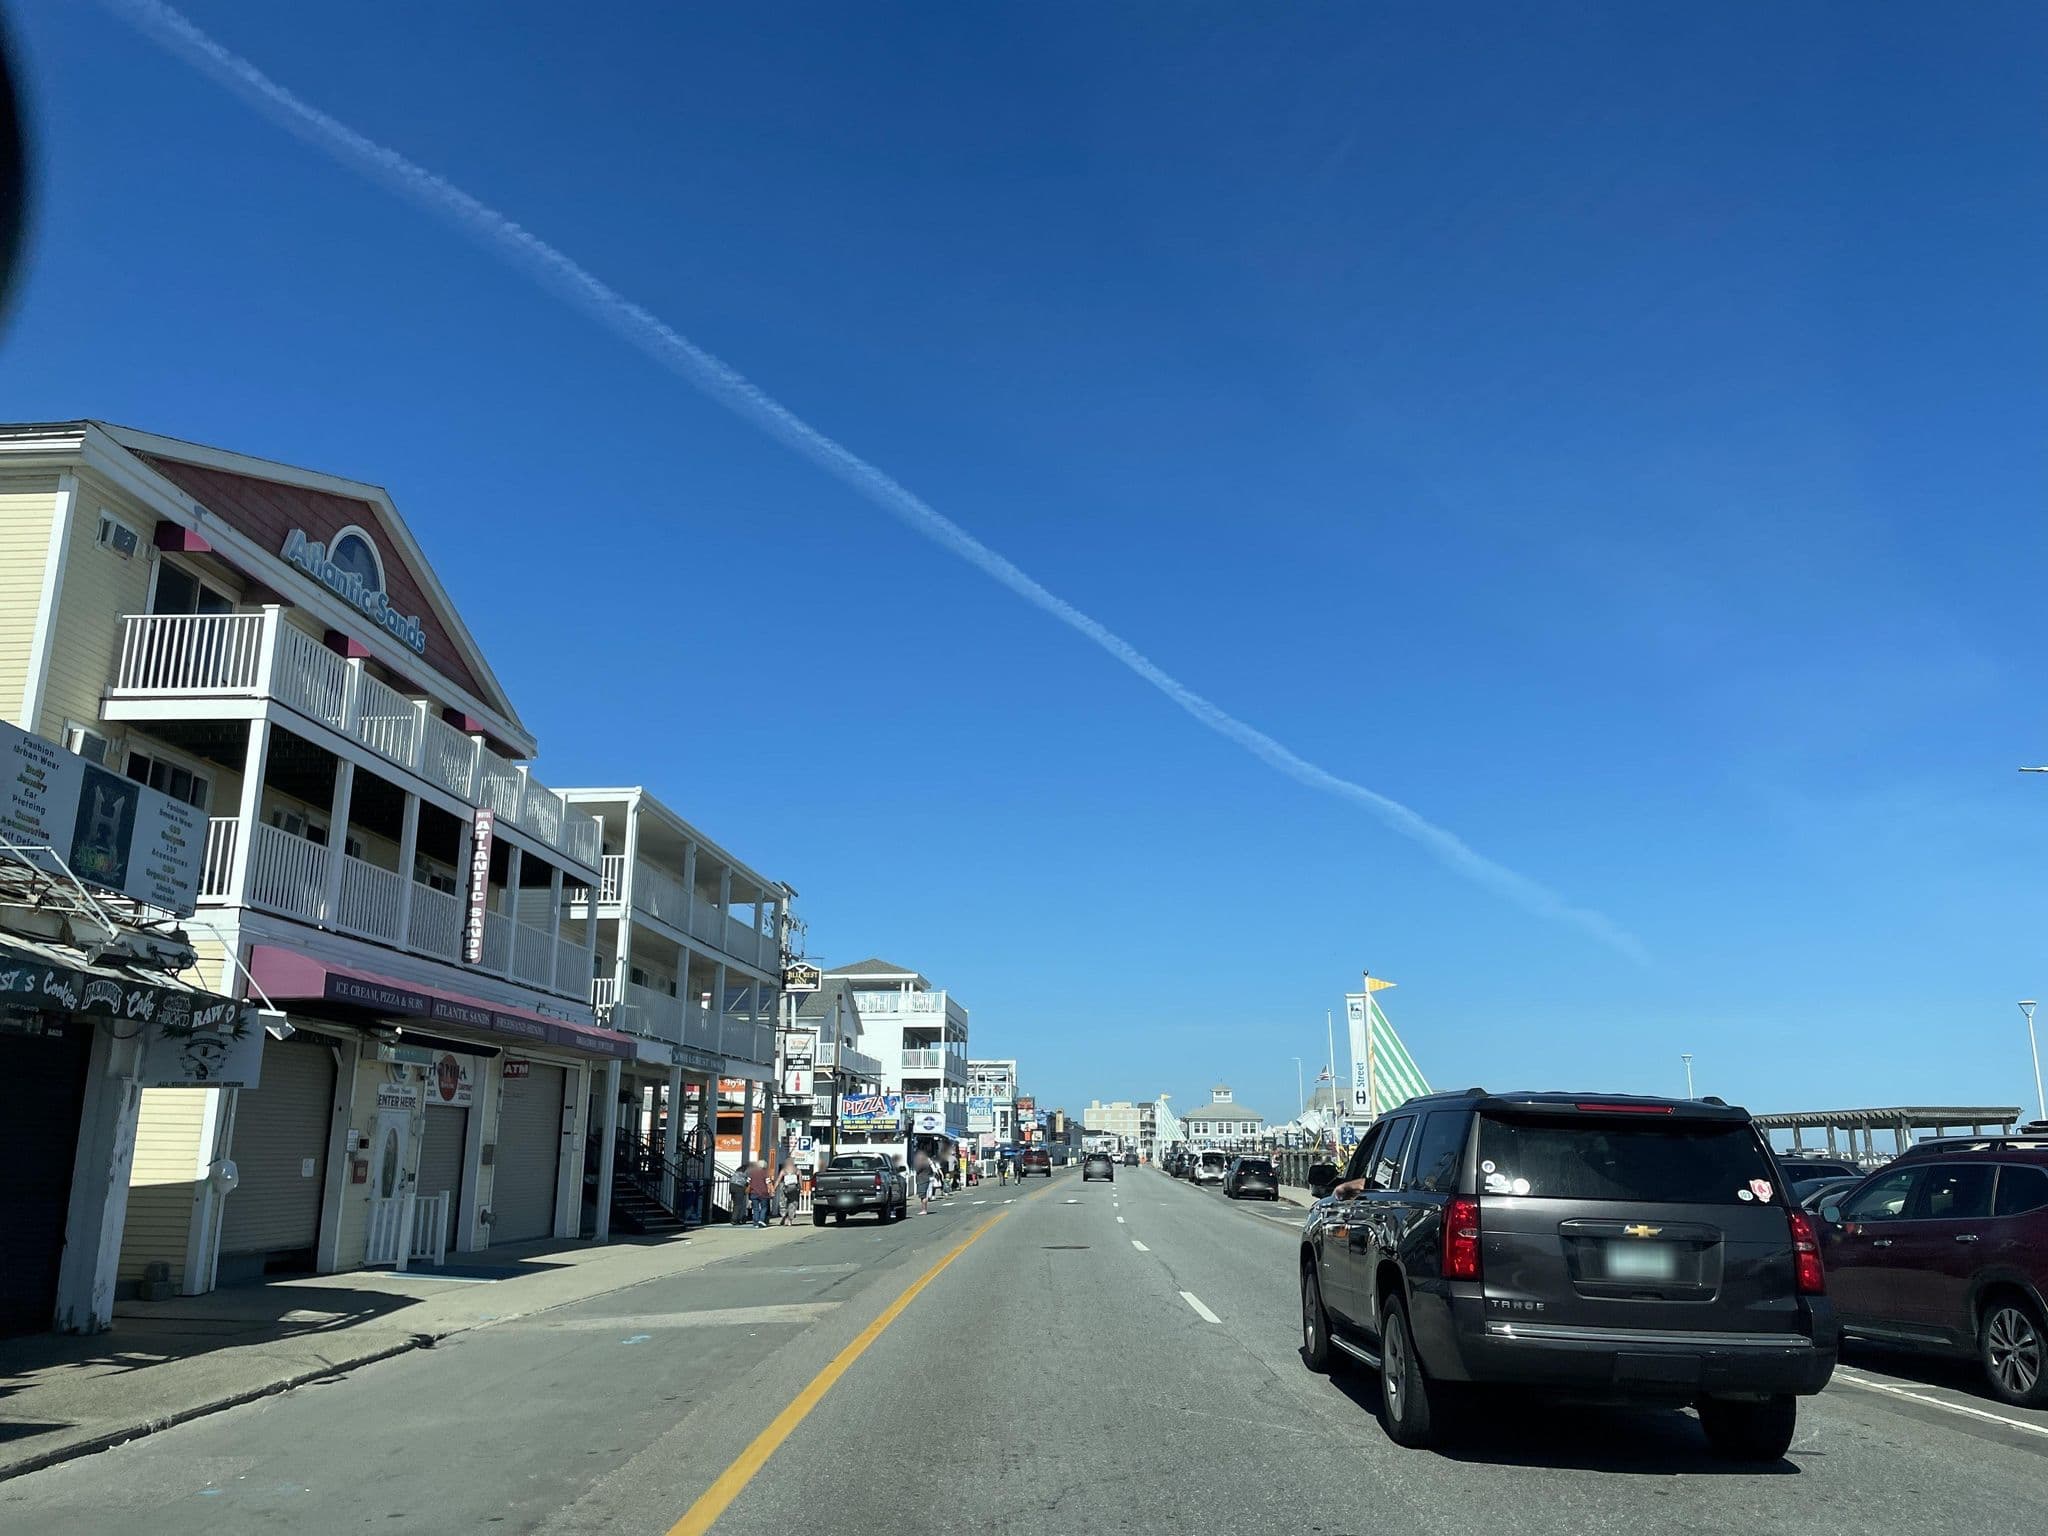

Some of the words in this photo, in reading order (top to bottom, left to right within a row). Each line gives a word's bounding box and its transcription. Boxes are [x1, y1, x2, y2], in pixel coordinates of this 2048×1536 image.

[280, 529, 371, 614] Atlantic
[373, 590, 427, 654] Sands
[471, 820, 490, 902] ATLANTIC
[464, 908, 483, 959] SANDS
[43, 971, 79, 1010] Cookies
[191, 1006, 223, 1029] RAW
[335, 981, 349, 995] ICE
[350, 983, 379, 1003] CREAM,
[380, 991, 400, 1006] PIZZA
[401, 997, 407, 1007] &
[408, 997, 424, 1009] SUBS
[434, 1003, 468, 1021] ATLANTIC
[469, 1010, 491, 1026] SANDS
[503, 1064, 529, 1075] ATM
[1356, 1062, 1365, 1088] Street
[378, 1094, 399, 1107] ENTER
[400, 1096, 417, 1109] HERE
[842, 1096, 887, 1116] PIZZA
[1355, 1090, 1367, 1105] H
[969, 1107, 991, 1116] MOTEL
[800, 1139, 810, 1150] P
[1491, 1299, 1545, 1311] TAHOE
